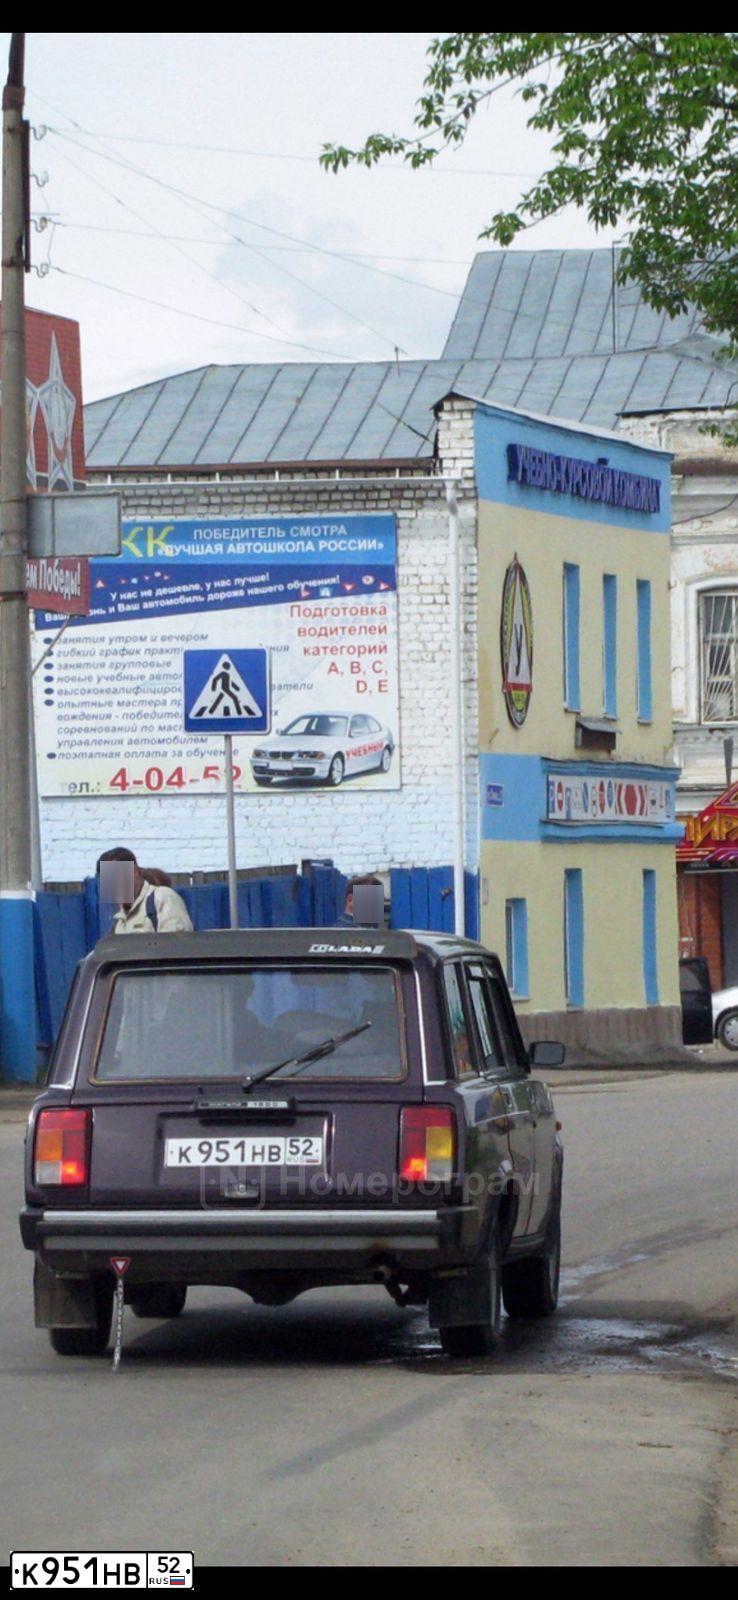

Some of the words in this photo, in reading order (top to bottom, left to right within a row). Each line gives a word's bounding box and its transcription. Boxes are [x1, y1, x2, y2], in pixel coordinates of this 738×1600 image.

[193, 525, 286, 541] ПОБЕДИТЕЛЬ
[290, 524, 348, 538] СМОТРА
[227, 541, 316, 555] АВТОШКОЛА
[318, 539, 384, 552] РОССИИ»
[120, 590, 138, 600] нас
[141, 588, 152, 598] не
[155, 583, 204, 598] дешевле,
[214, 578, 231, 588] нас
[234, 572, 270, 586] лучше!
[44, 612, 69, 622] Ваш
[109, 605, 115, 614] и
[117, 602, 140, 613] Ваш
[143, 595, 205, 610] автомобиль
[207, 590, 245, 602] дороже
[247, 584, 285, 597] нашего
[287, 575, 341, 592] обучения!
[290, 604, 388, 619] Подготовка
[297, 623, 388, 638] водителей
[57, 636, 105, 646] занятия
[108, 635, 148, 646] утром
[160, 633, 209, 643] вечером
[56, 648, 96, 658] гибкий
[99, 647, 141, 658] график
[303, 642, 388, 658] категорий
[56, 661, 106, 670] занятия
[108, 660, 172, 671] групповые
[56, 674, 93, 683] новые
[97, 672, 146, 684] учебные
[57, 700, 114, 709] опытные
[116, 700, 168, 708] мастера
[57, 711, 112, 722] вождения
[57, 724, 139, 735] соревнований
[140, 725, 155, 734] по
[57, 737, 124, 749] управления
[127, 735, 208, 746] автомобилем
[58, 750, 121, 761] поэтапная
[124, 749, 168, 760] оплата
[170, 749, 183, 759] за
[186, 747, 239, 759] обучене
[328, 945, 373, 953] LADA
[288, 1138, 314, 1156] 52
